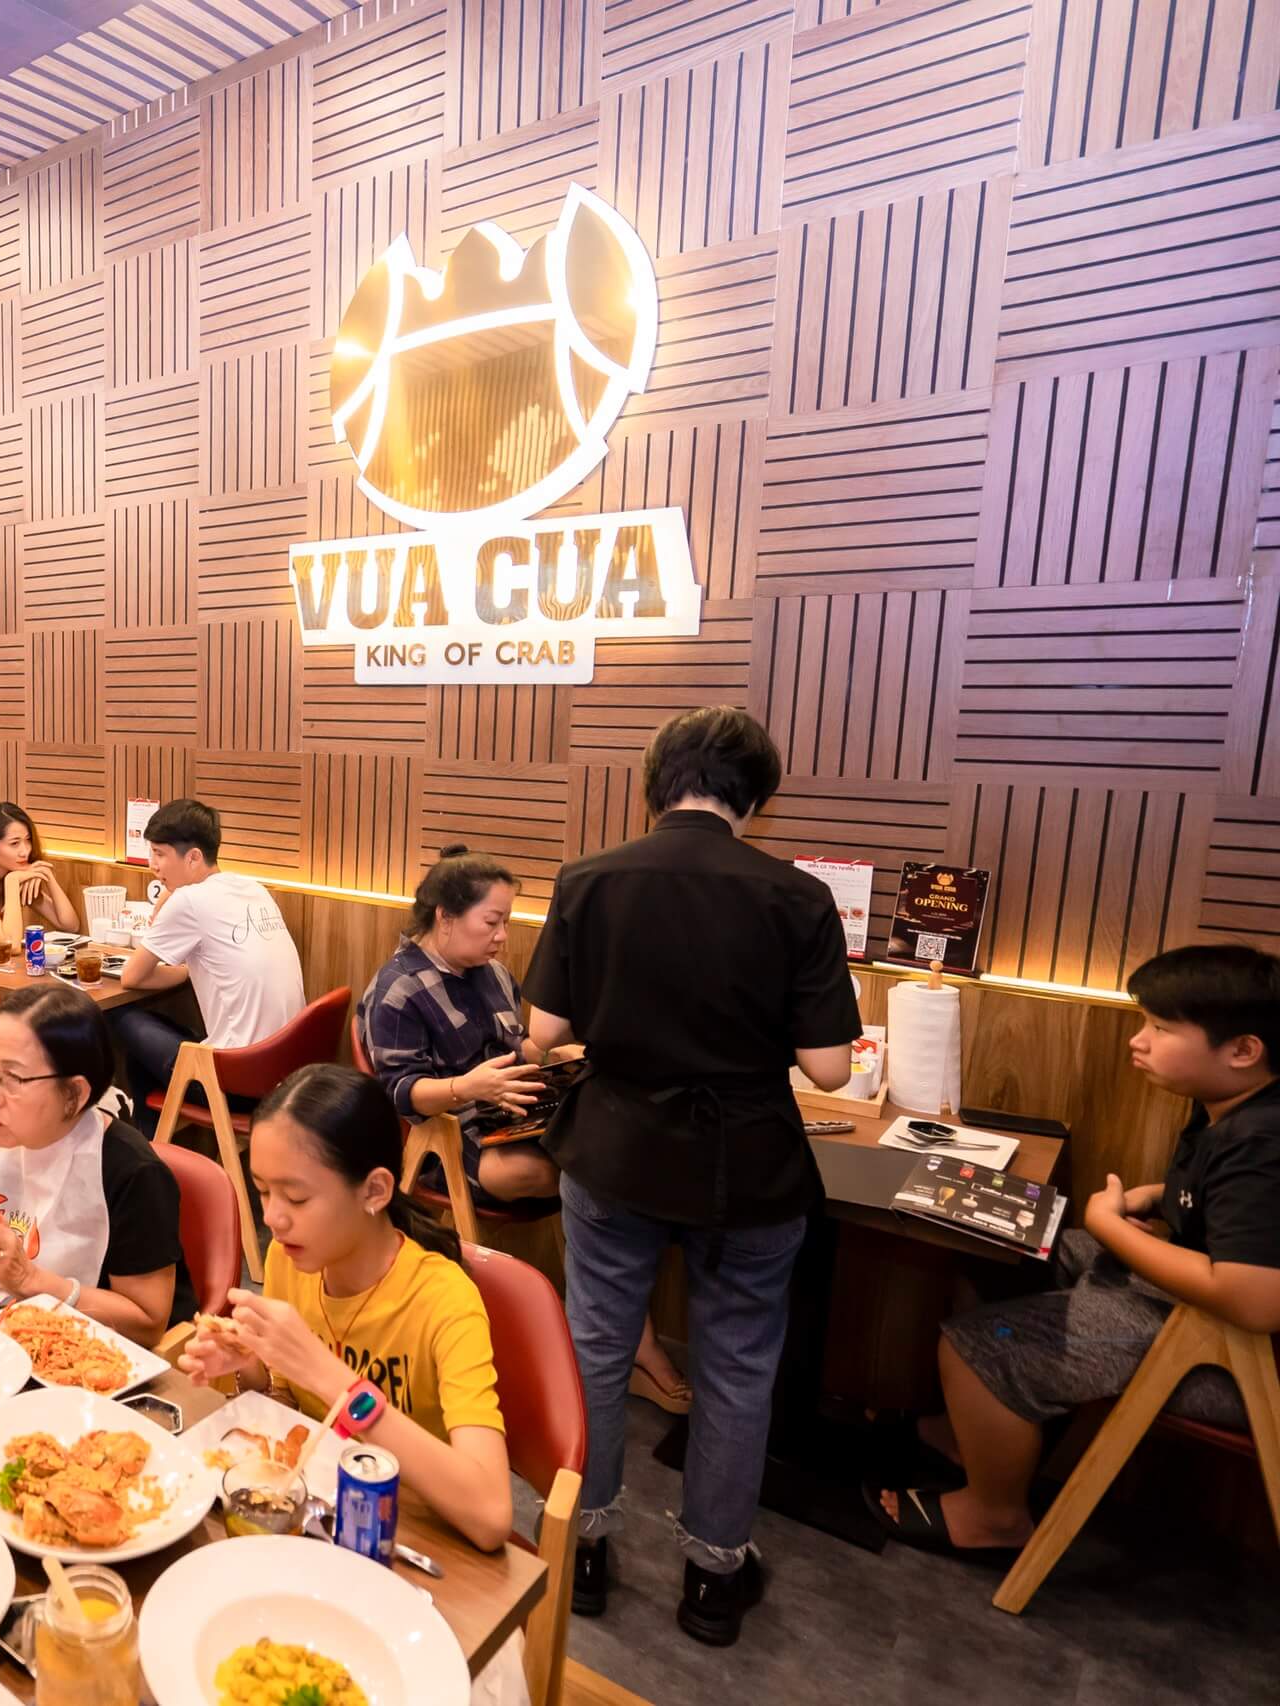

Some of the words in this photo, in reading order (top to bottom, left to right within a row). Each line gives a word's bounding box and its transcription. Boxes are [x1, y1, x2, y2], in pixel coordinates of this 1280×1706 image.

[292, 544, 449, 631] VUA
[475, 525, 667, 626] CUA
[366, 643, 427, 668] KING
[443, 641, 483, 667] OF
[494, 639, 576, 666] CRAB
[153, 884, 161, 899] 2
[929, 893, 956, 903] GRAND
[914, 897, 969, 912] OPENING
